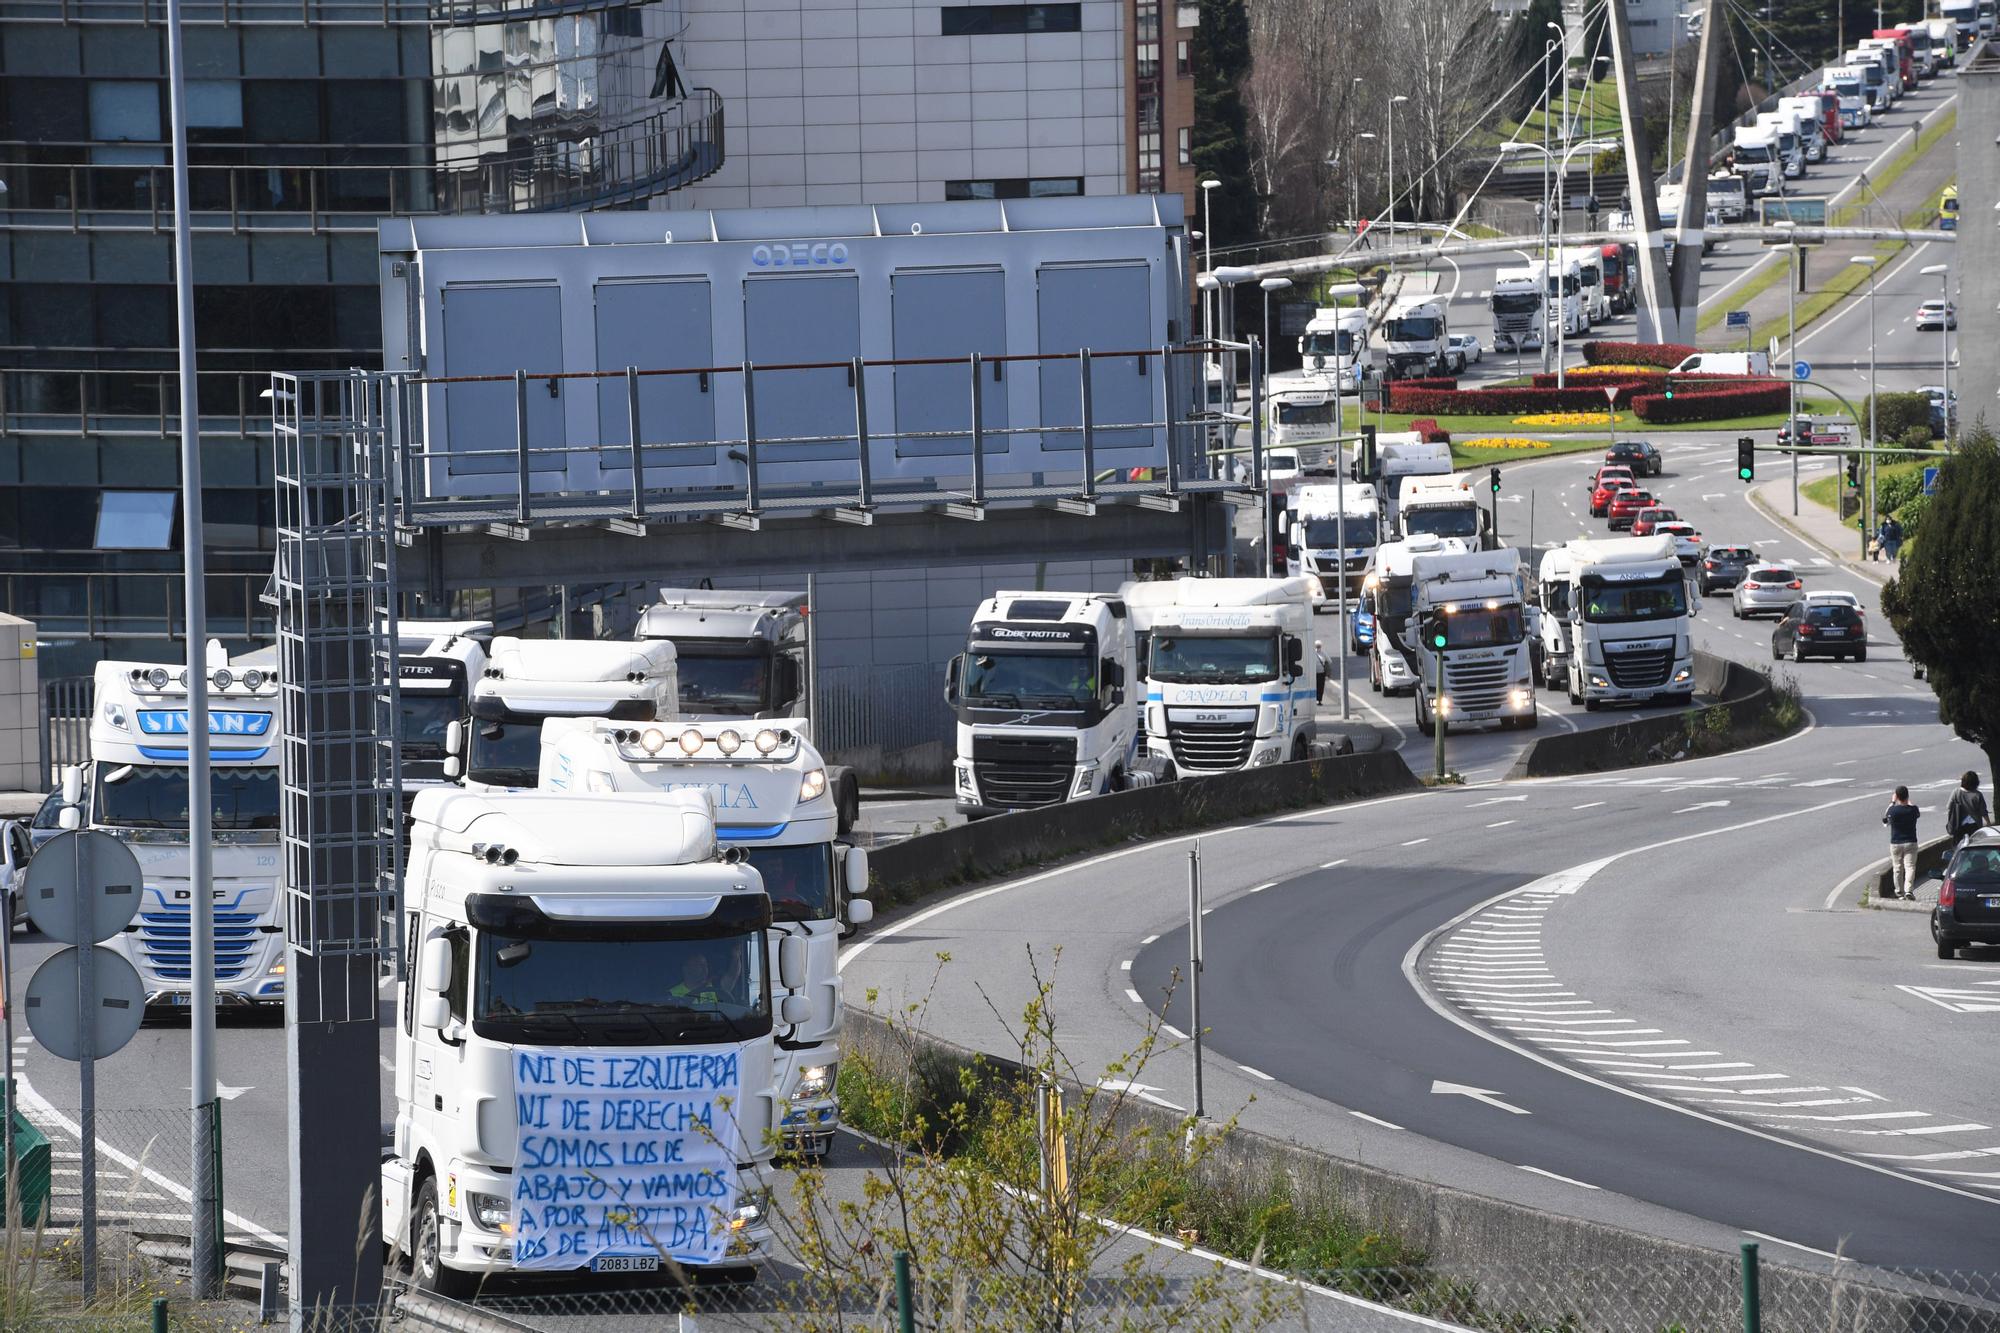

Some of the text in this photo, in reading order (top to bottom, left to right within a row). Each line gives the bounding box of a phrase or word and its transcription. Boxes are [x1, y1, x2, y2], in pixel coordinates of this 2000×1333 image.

[752, 243, 848, 266] ODECO
[992, 628, 1070, 638] GLOBETROTTER
[1176, 688, 1248, 703] CANDELA
[256, 856, 276, 866] 120
[175, 890, 225, 899] DF
[519, 1053, 738, 1090] NI DE IZQUIERDA
[519, 1093, 713, 1132] NI DE DERECHA
[522, 1136, 684, 1169] SOMOS LOS DE
[517, 1170, 728, 1202] ABAJO Y VAMOS
[518, 1204, 589, 1232] A POR
[558, 1231, 588, 1256] DE
[600, 1258, 655, 1271] 2083 LBZ
